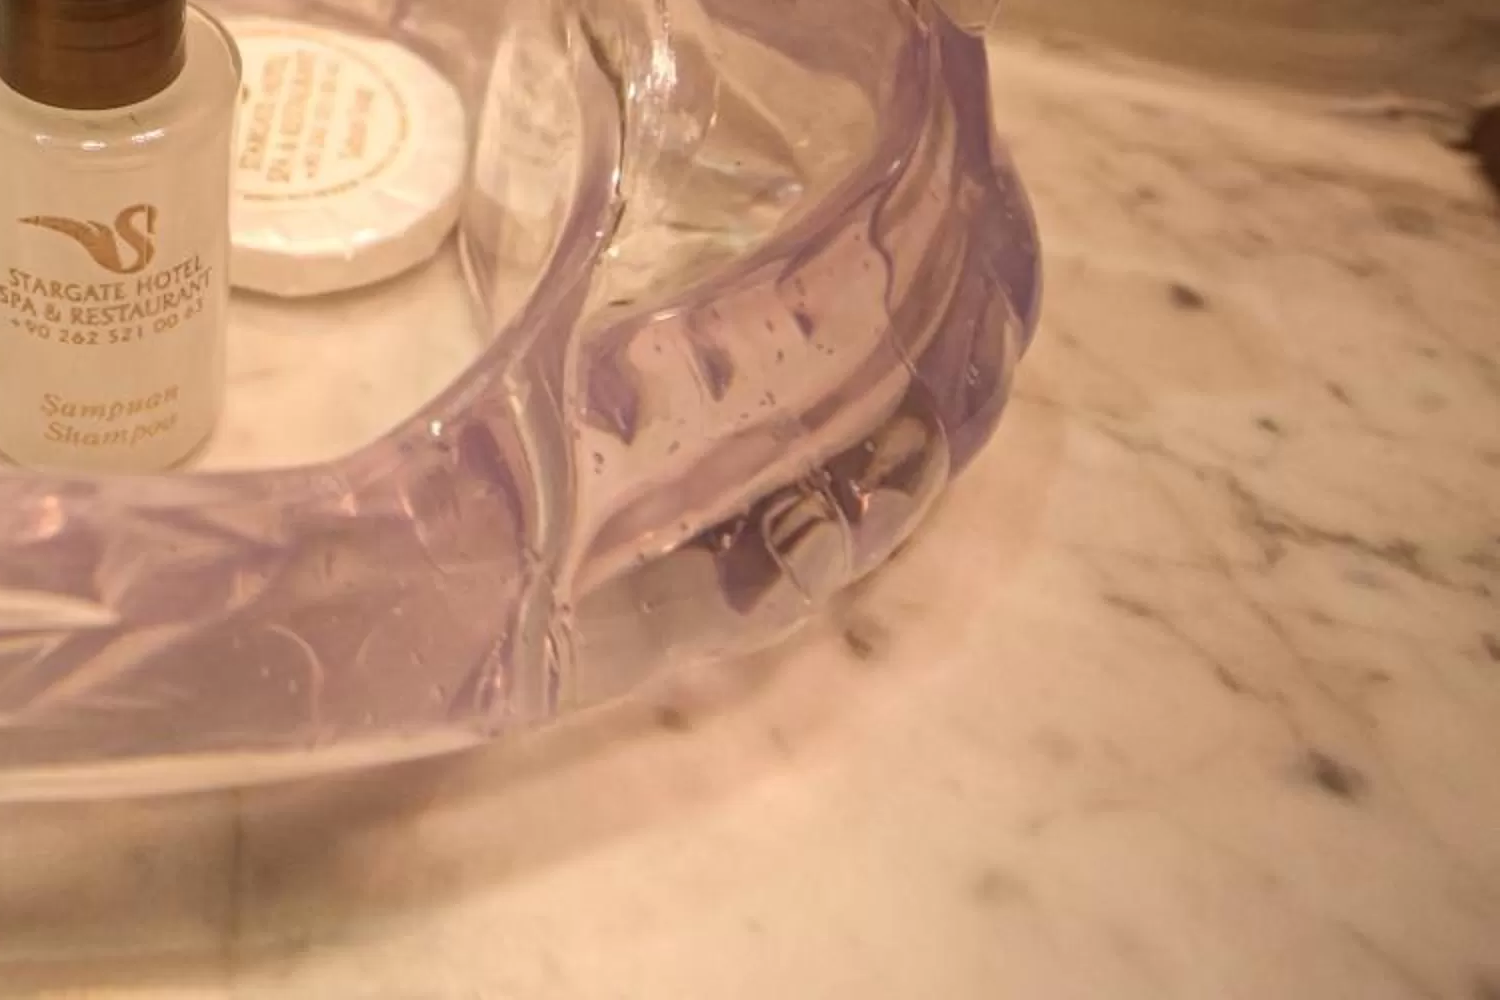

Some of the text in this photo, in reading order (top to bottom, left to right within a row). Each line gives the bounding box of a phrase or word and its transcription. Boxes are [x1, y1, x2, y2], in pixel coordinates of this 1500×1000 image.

[8, 255, 204, 303] STARGATE HOTEL
[44, 303, 61, 324] &
[70, 266, 212, 327] RESTAURANT
[59, 328, 99, 345] 262
[108, 326, 144, 344] 521
[153, 313, 180, 334] 00
